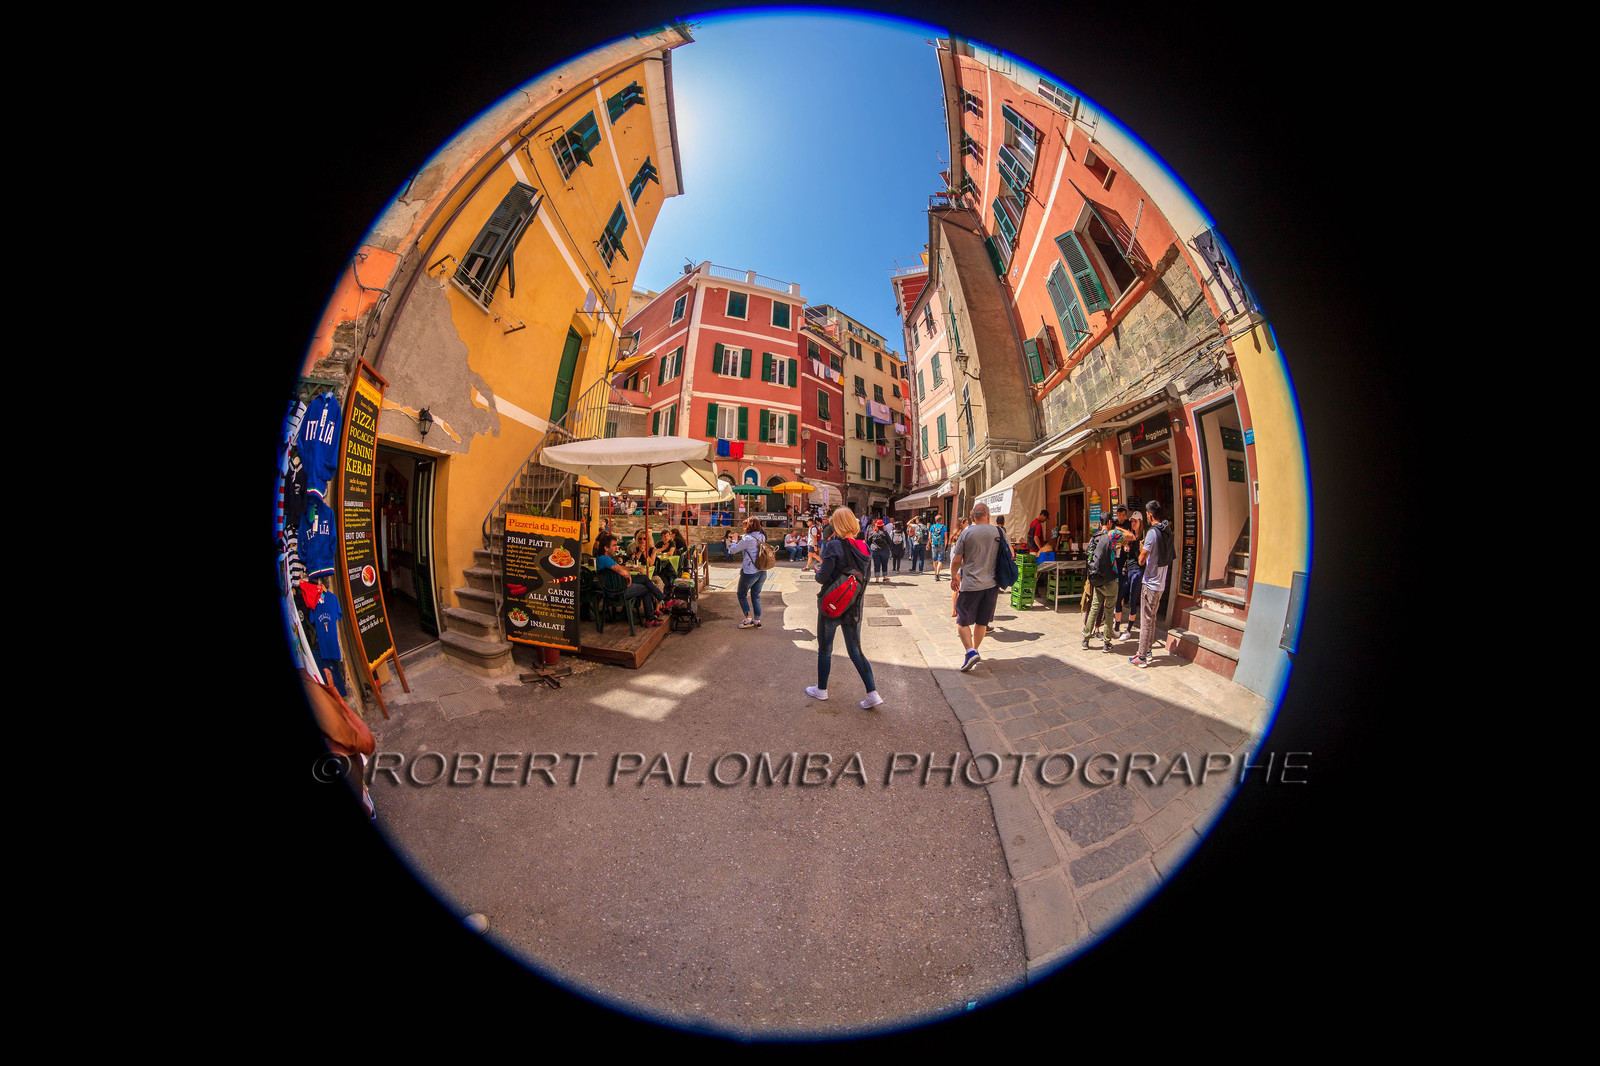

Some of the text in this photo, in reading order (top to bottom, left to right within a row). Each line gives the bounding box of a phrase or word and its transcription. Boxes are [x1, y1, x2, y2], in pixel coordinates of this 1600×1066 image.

[352, 407, 375, 432] PIZZA
[350, 426, 374, 445] FOCACCE
[348, 440, 373, 460] PANINI
[346, 457, 372, 477] KEBAB
[508, 518, 578, 535] Pizzeria da Ercole
[507, 536, 553, 548] PRIMI PIATTI
[528, 593, 548, 602] ALLA
[550, 595, 575, 605] BRACE
[547, 588, 575, 598] CARNE
[530, 620, 566, 631] INSALATE
